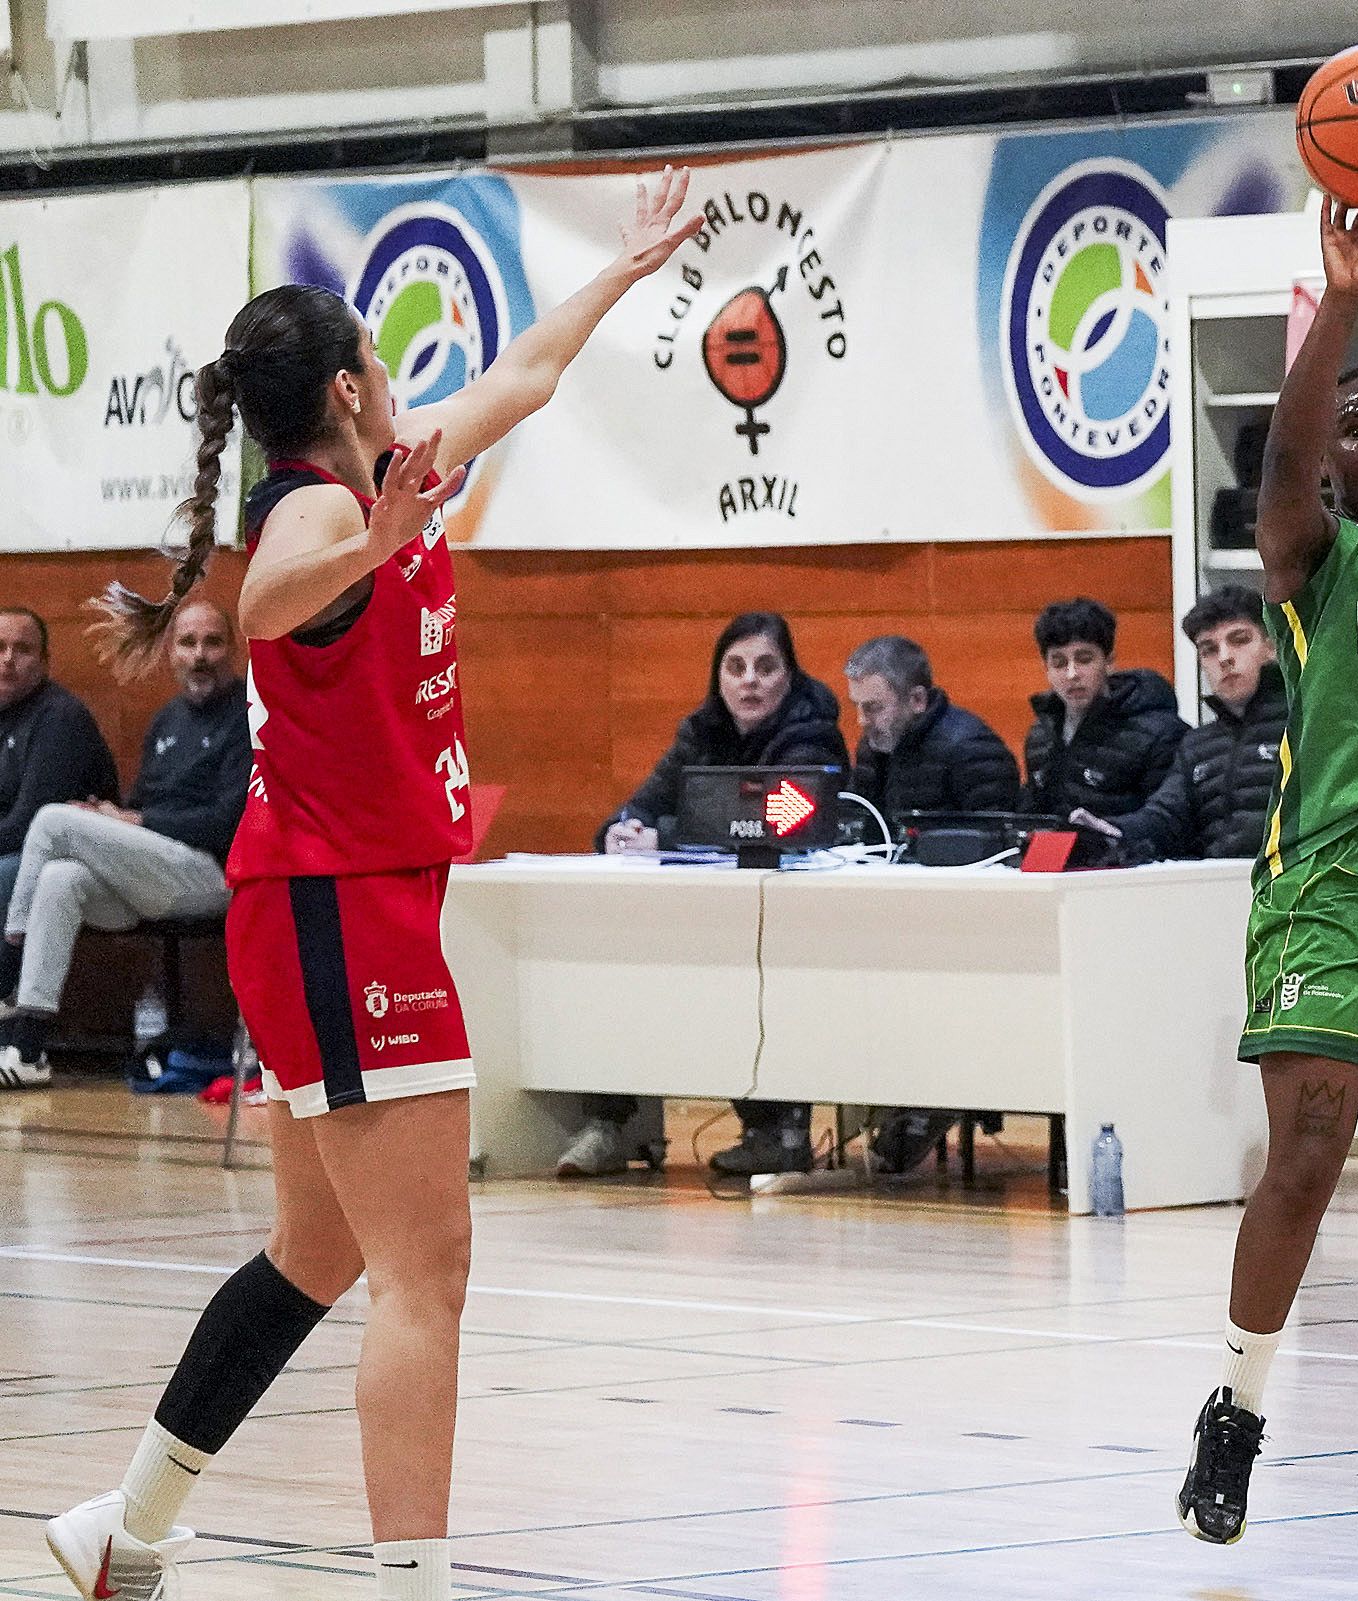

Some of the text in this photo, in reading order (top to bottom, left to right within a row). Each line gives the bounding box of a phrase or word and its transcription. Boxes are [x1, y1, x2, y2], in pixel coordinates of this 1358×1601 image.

[1042, 215, 1163, 284] DEPORTE
[653, 262, 703, 370] CLUB
[1034, 337, 1170, 448] PONTEVEDR
[719, 473, 798, 522] ARXIL
[393, 989, 448, 1004] Deputación
[388, 1033, 419, 1045] WIBO
